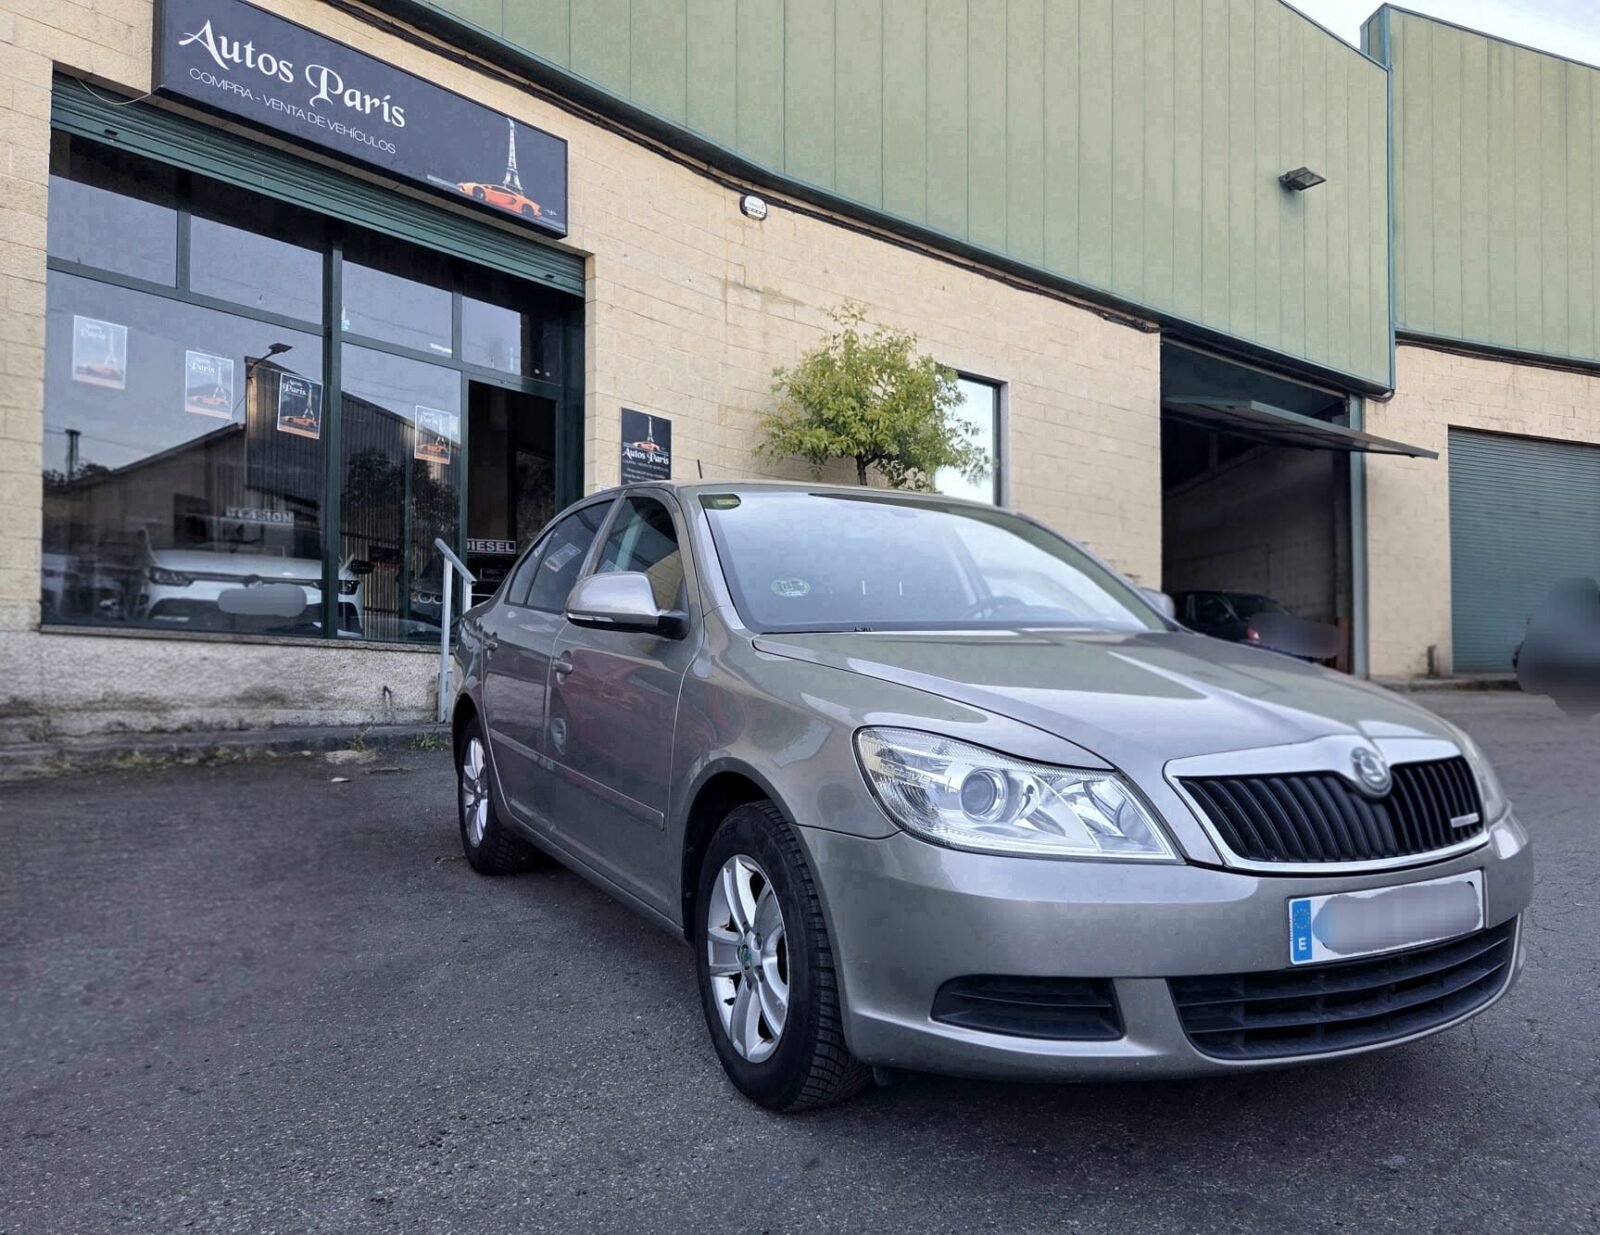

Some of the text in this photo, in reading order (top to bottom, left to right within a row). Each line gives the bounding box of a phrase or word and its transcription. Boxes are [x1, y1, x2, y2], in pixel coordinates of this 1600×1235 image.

[178, 19, 405, 128] Autos París
[189, 67, 254, 101] COMPRA
[263, 94, 306, 120] VENTA
[307, 111, 327, 128] DE
[622, 447, 646, 461] Autos
[1298, 936, 1308, 951] E
